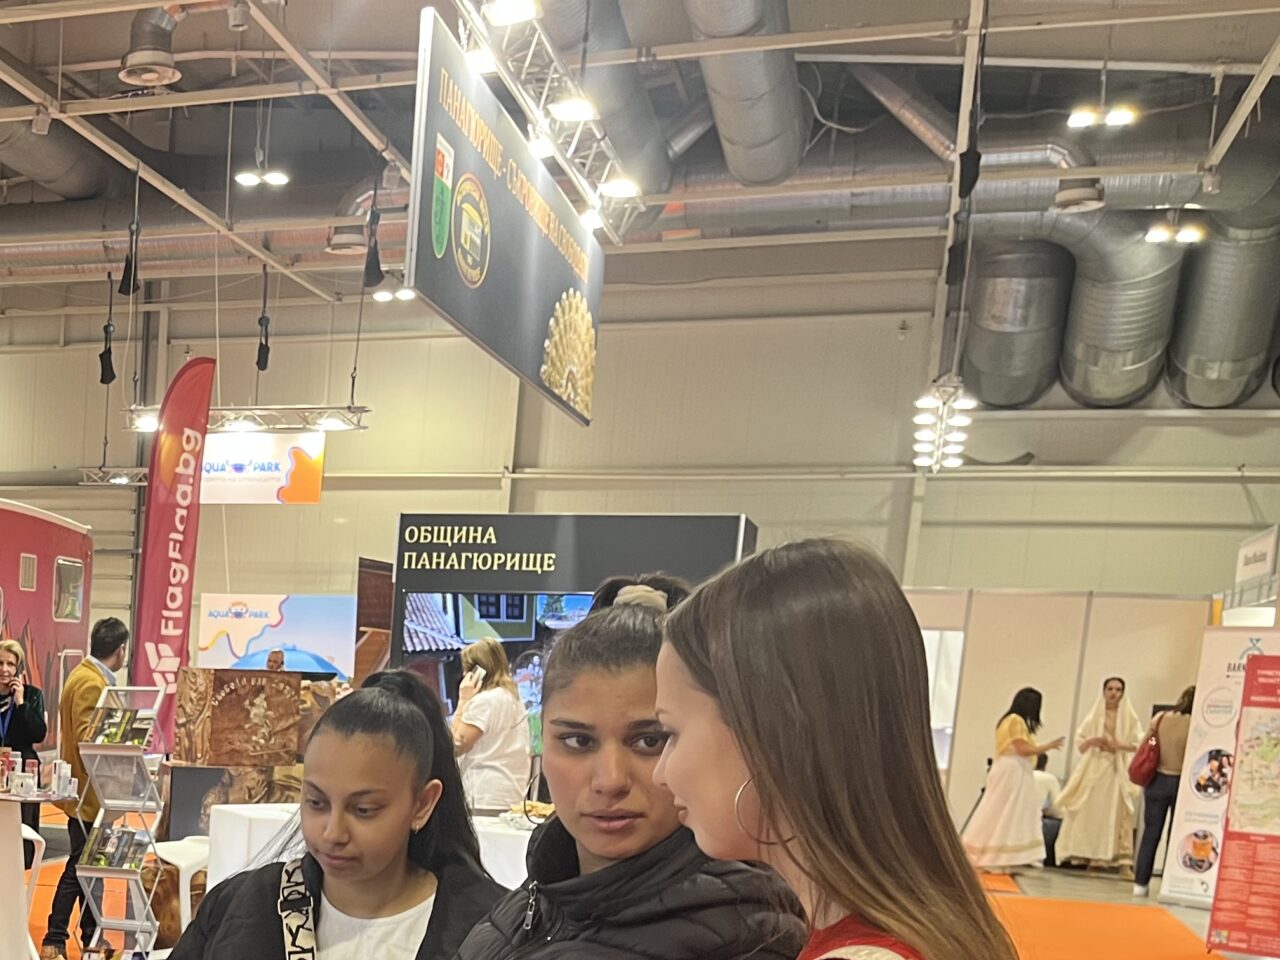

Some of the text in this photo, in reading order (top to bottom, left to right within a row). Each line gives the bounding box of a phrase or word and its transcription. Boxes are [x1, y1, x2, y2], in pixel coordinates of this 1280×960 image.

[438, 66, 504, 181] ПАНАГЮРИЩЕ
[201, 462, 281, 474] QUA PARK
[404, 525, 497, 547] ОБЩИНА
[403, 551, 557, 574] ПАНАГЮРИЩЕ
